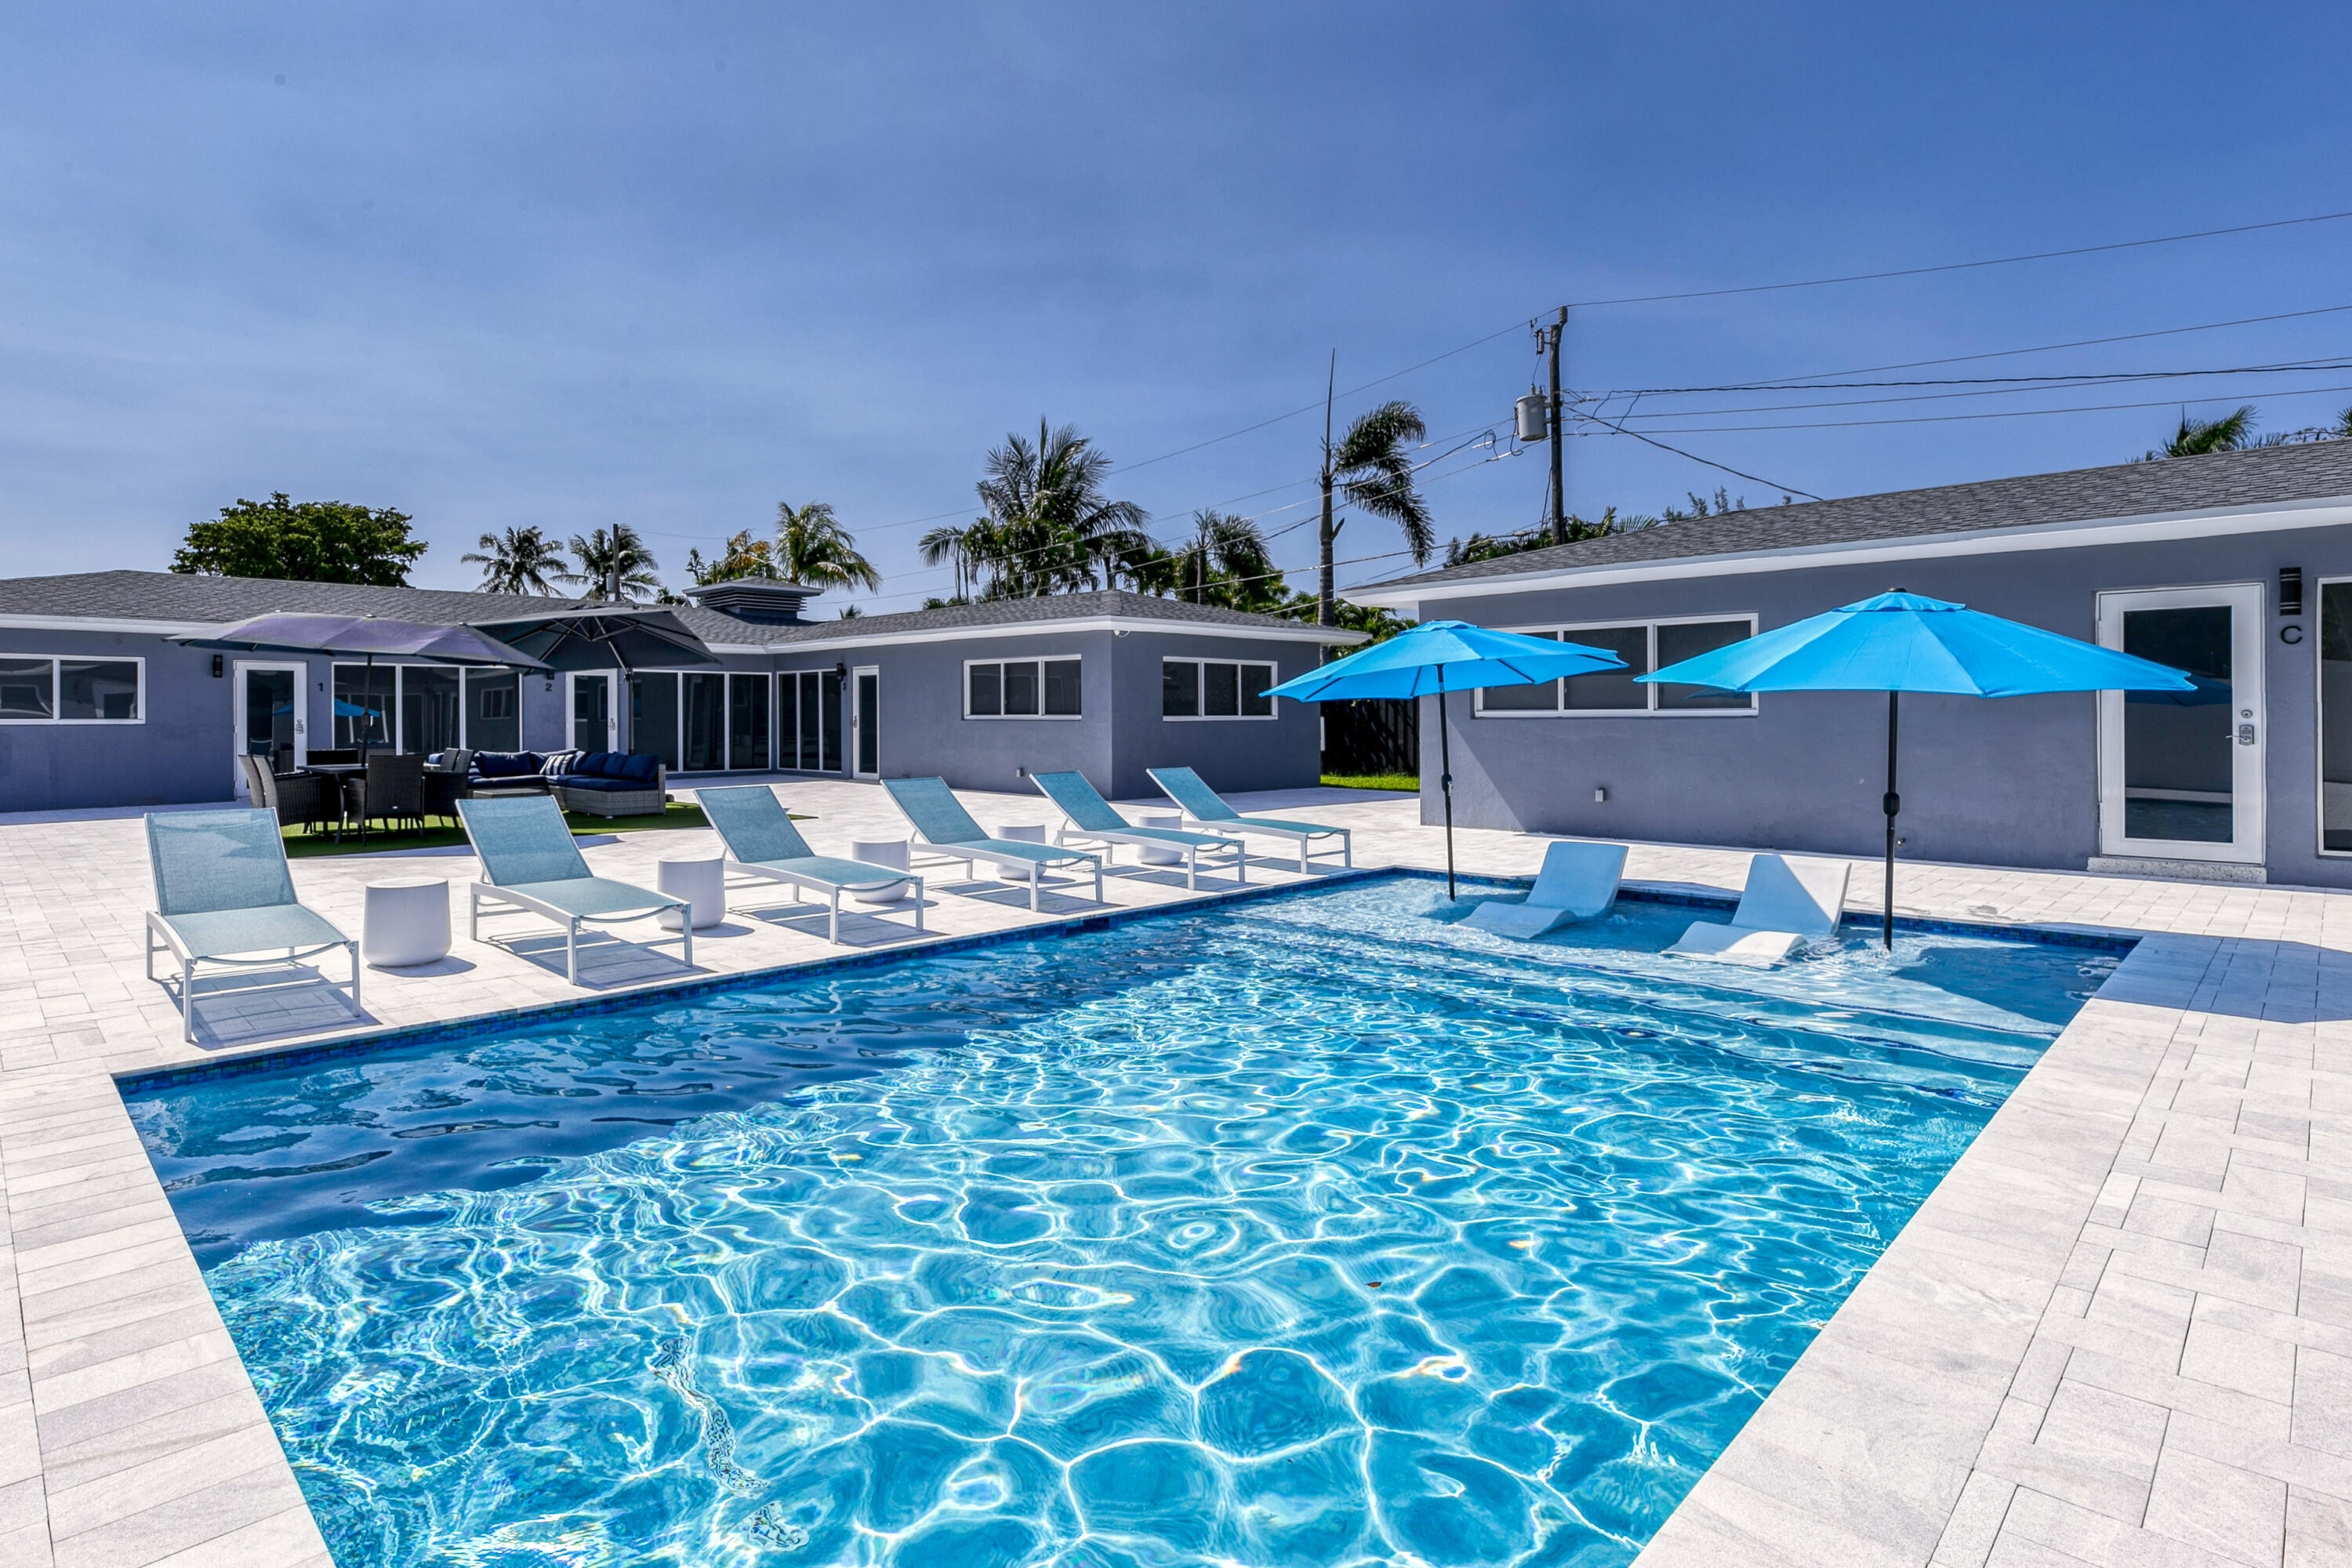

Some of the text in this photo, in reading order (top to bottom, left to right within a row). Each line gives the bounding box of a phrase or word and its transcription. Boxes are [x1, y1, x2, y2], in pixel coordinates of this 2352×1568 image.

[2280, 626, 2303, 644] C
[318, 682, 323, 691] 1
[545, 683, 552, 691] 2
